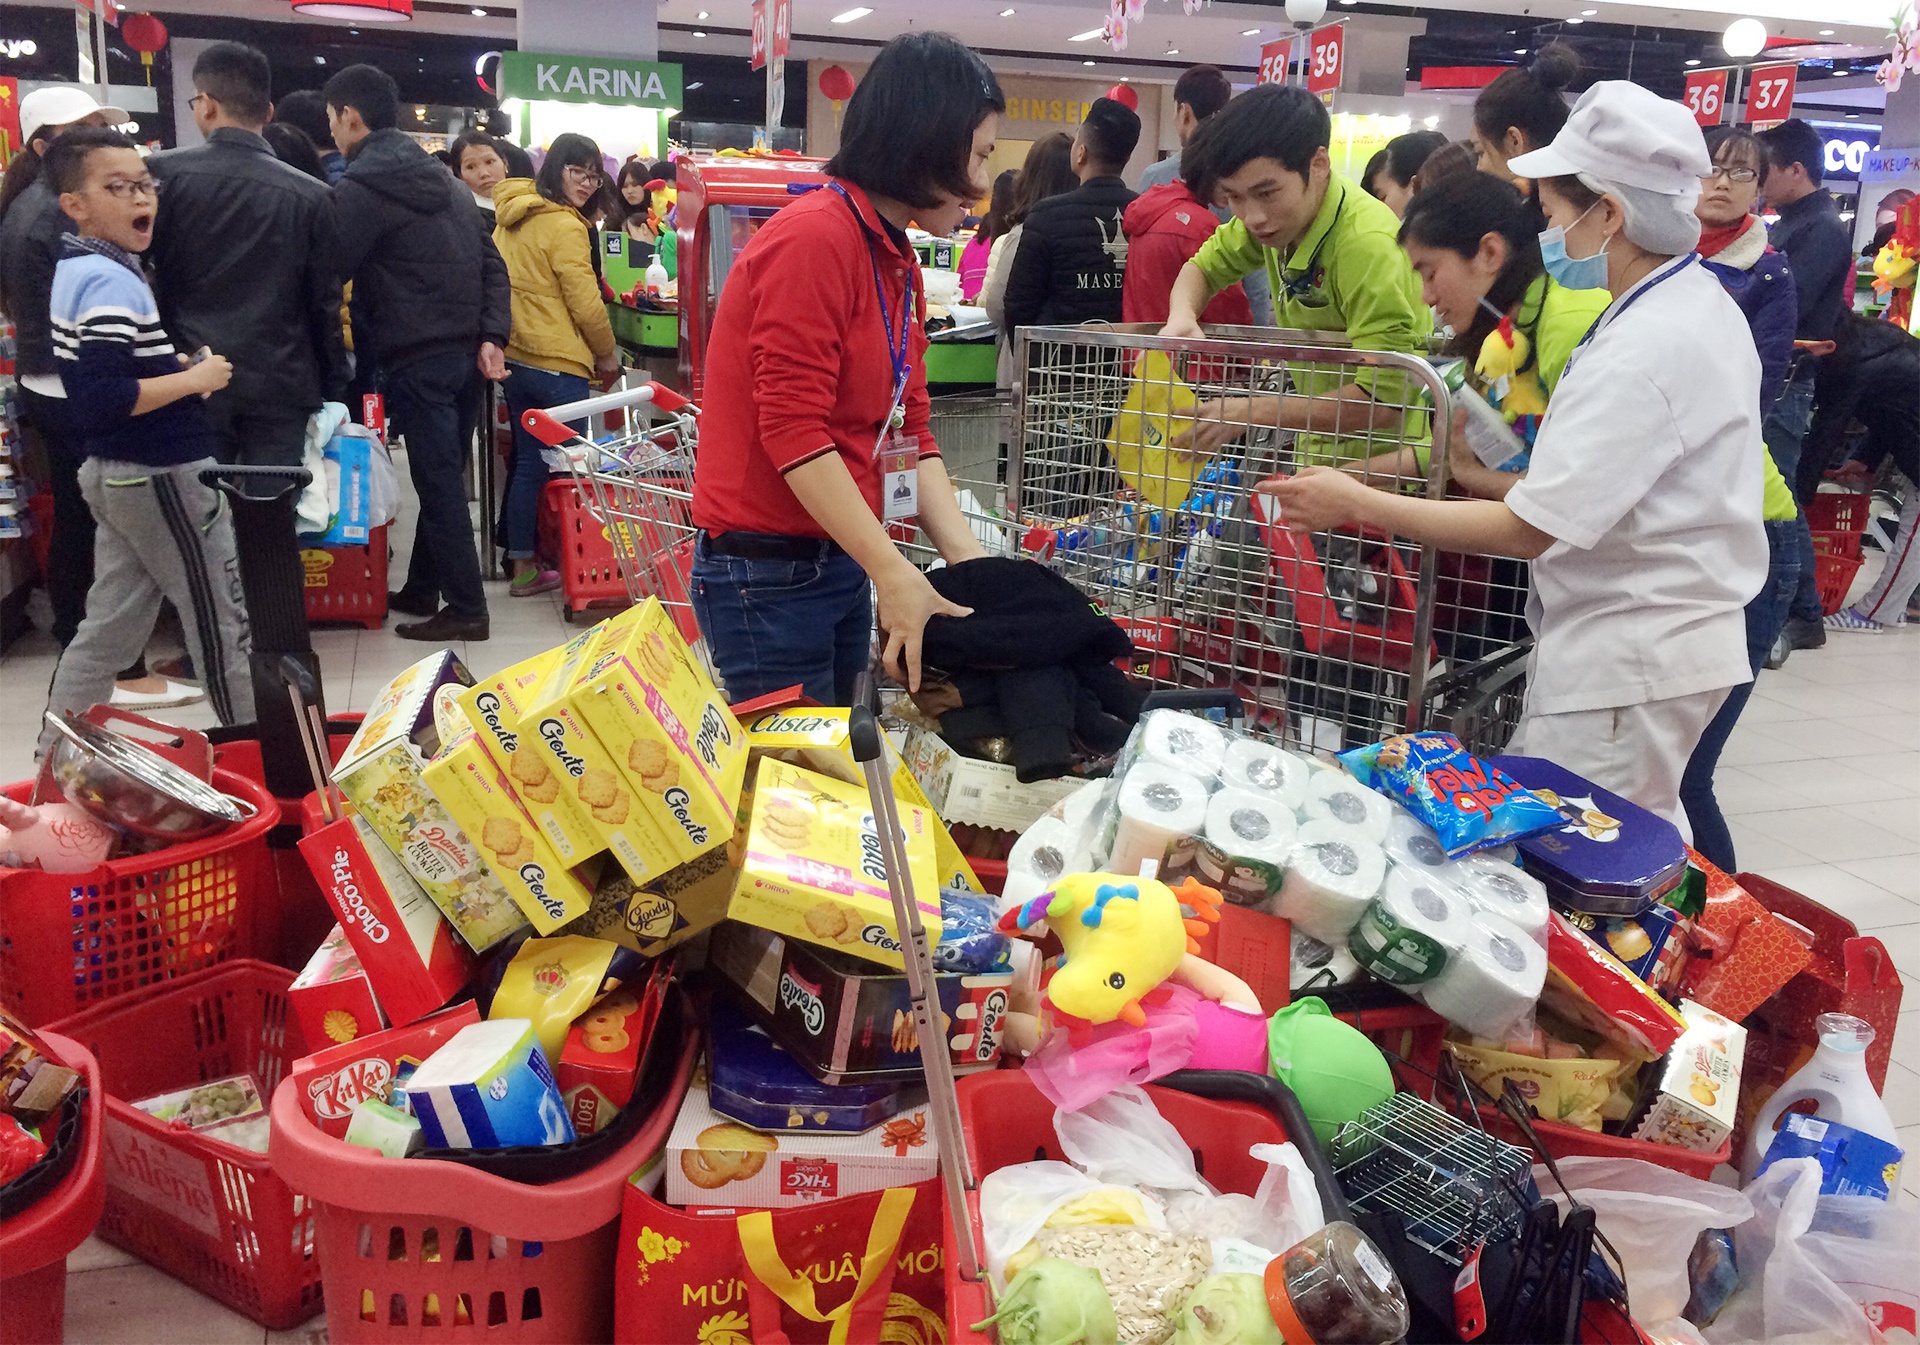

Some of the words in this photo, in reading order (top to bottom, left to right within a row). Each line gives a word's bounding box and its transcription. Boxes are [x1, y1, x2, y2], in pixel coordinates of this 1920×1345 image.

[1258, 53, 1285, 87] 38
[1313, 40, 1339, 78] 39
[536, 63, 667, 100] KARINA
[1755, 78, 1789, 110] 37
[1688, 84, 1719, 116] 36
[1824, 139, 1881, 173] CO
[502, 690, 520, 715] ORION
[623, 691, 641, 715] ORION
[476, 692, 518, 754] Gouté
[566, 716, 585, 740] ORION
[750, 712, 838, 736] Custas
[539, 718, 585, 777] Gouté
[473, 770, 492, 794] ORION
[665, 788, 708, 845] Gouté
[407, 844, 440, 881] COOKIES
[417, 840, 446, 875] BUTTER
[419, 827, 470, 870] Danisa
[331, 886, 351, 917] ORION
[520, 863, 565, 919] Gouté
[763, 883, 791, 896] ORION
[628, 900, 671, 932] Goody
[780, 972, 826, 1036] Gouté
[976, 988, 1009, 1061] Gouté
[323, 1062, 385, 1115] KitKat
[786, 1172, 832, 1189] HKC
[795, 1165, 823, 1174] Cookies
